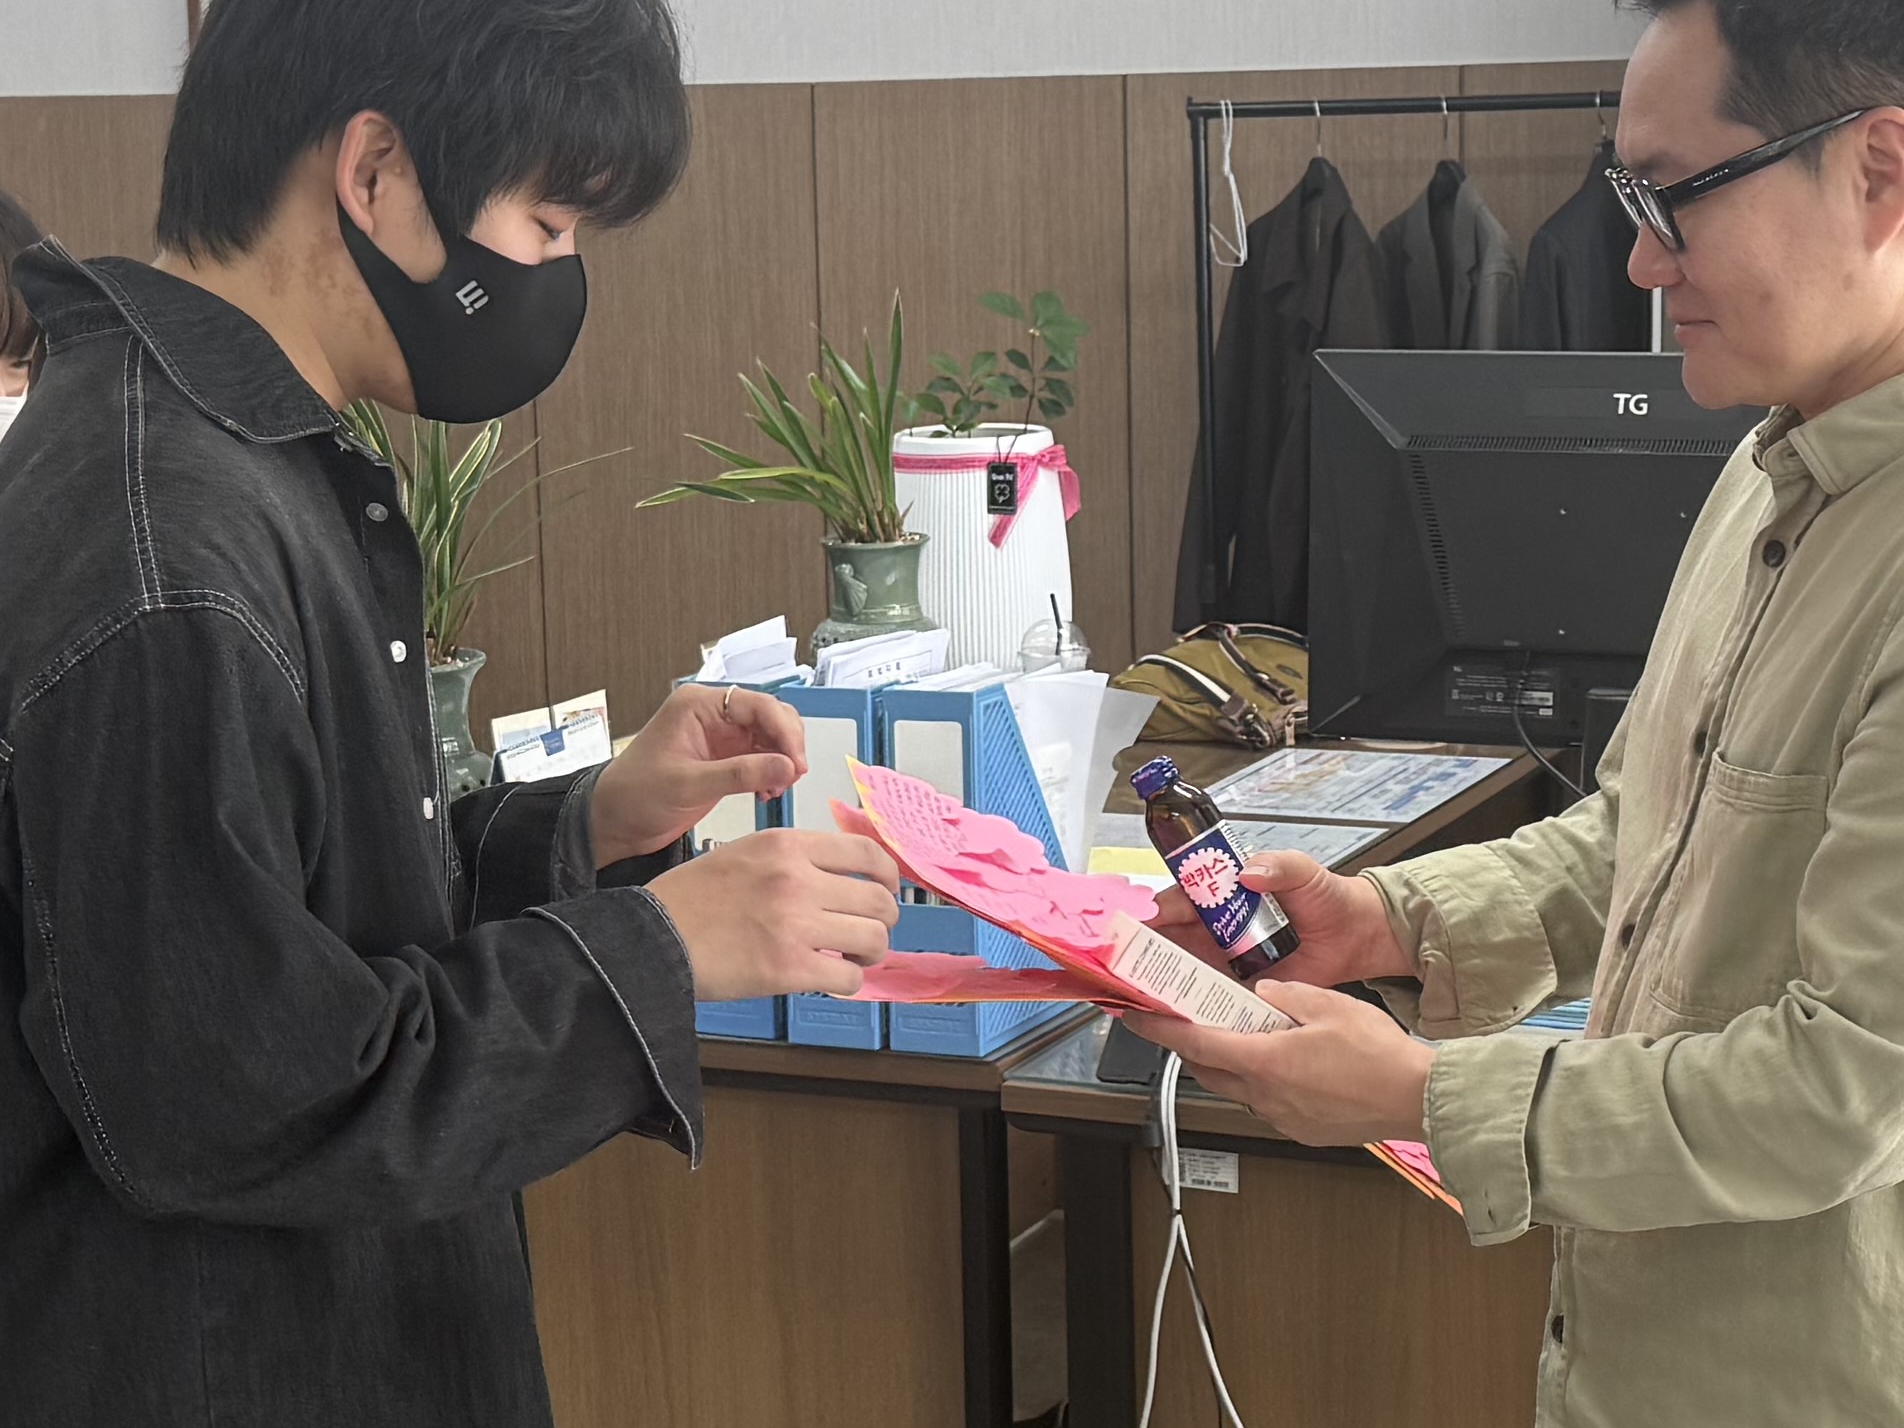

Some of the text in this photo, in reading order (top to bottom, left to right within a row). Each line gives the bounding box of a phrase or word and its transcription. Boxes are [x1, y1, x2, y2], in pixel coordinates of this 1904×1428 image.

[1613, 393, 1649, 416] TG
[1182, 857, 1229, 889] 박카스
[1207, 881, 1220, 897] F
